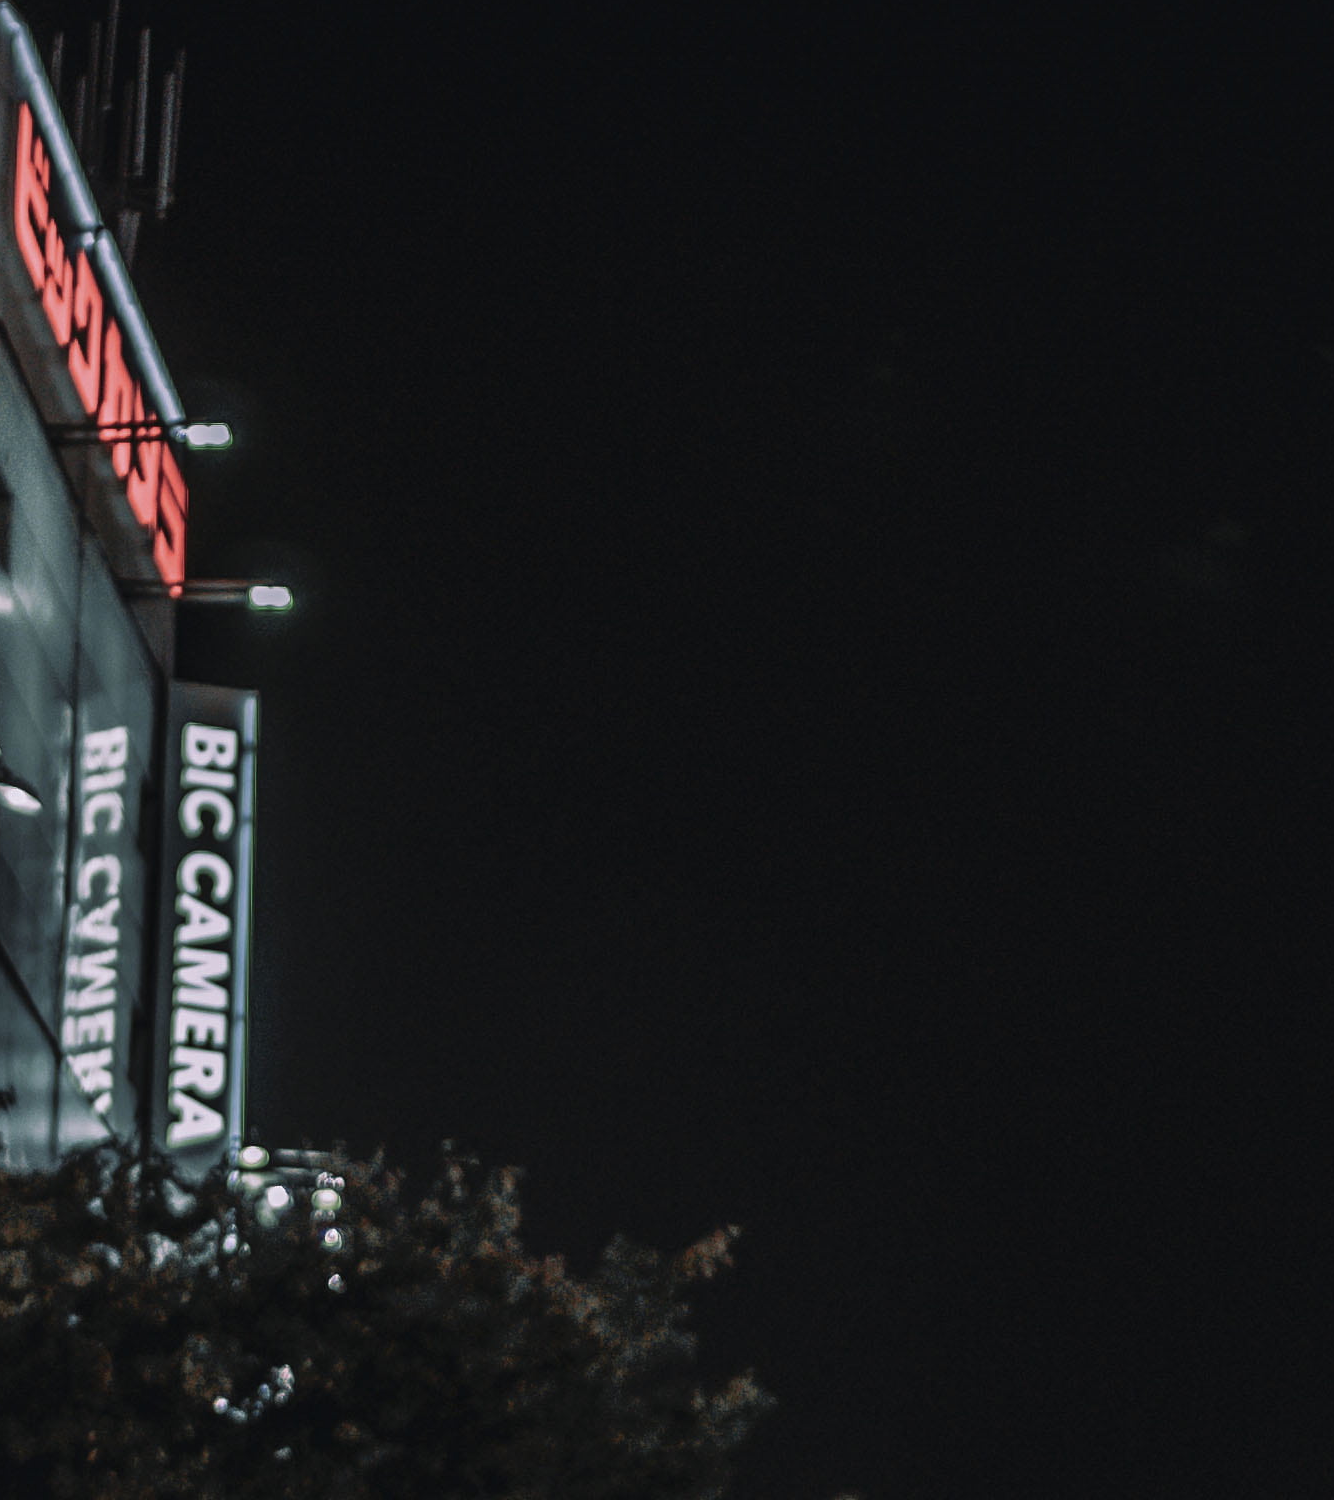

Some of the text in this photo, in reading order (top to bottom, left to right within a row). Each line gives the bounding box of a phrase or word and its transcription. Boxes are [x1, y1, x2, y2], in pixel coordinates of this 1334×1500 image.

[13, 98, 189, 595] ビックカメラ
[167, 722, 238, 1148] BIC CAMERA
